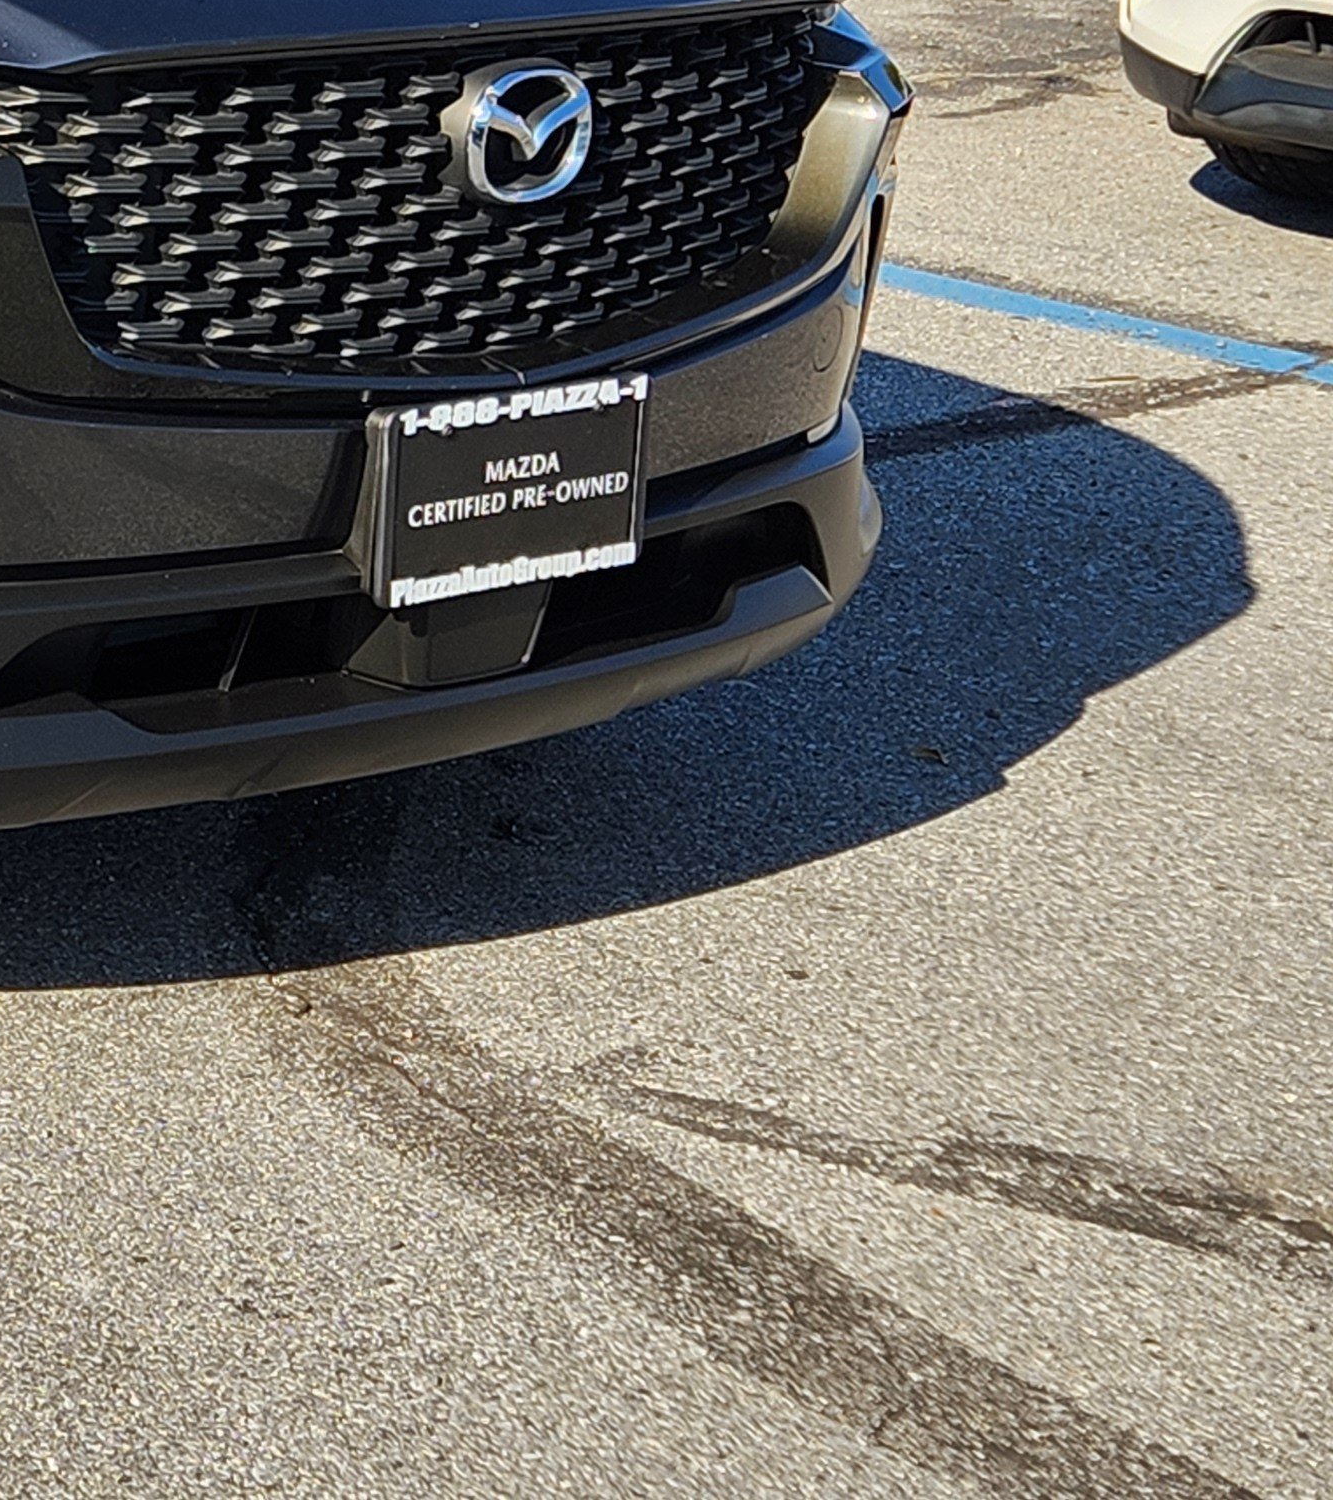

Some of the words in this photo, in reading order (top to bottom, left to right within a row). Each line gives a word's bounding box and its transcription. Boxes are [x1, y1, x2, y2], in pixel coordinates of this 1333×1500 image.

[400, 373, 649, 436] 1-888-PIAZZA-1
[485, 451, 560, 483] MAZDA
[408, 492, 506, 528] CERTIFIED
[512, 471, 629, 510] PRE-OWNED
[390, 542, 636, 608] PiazzaAutoGroup.com
